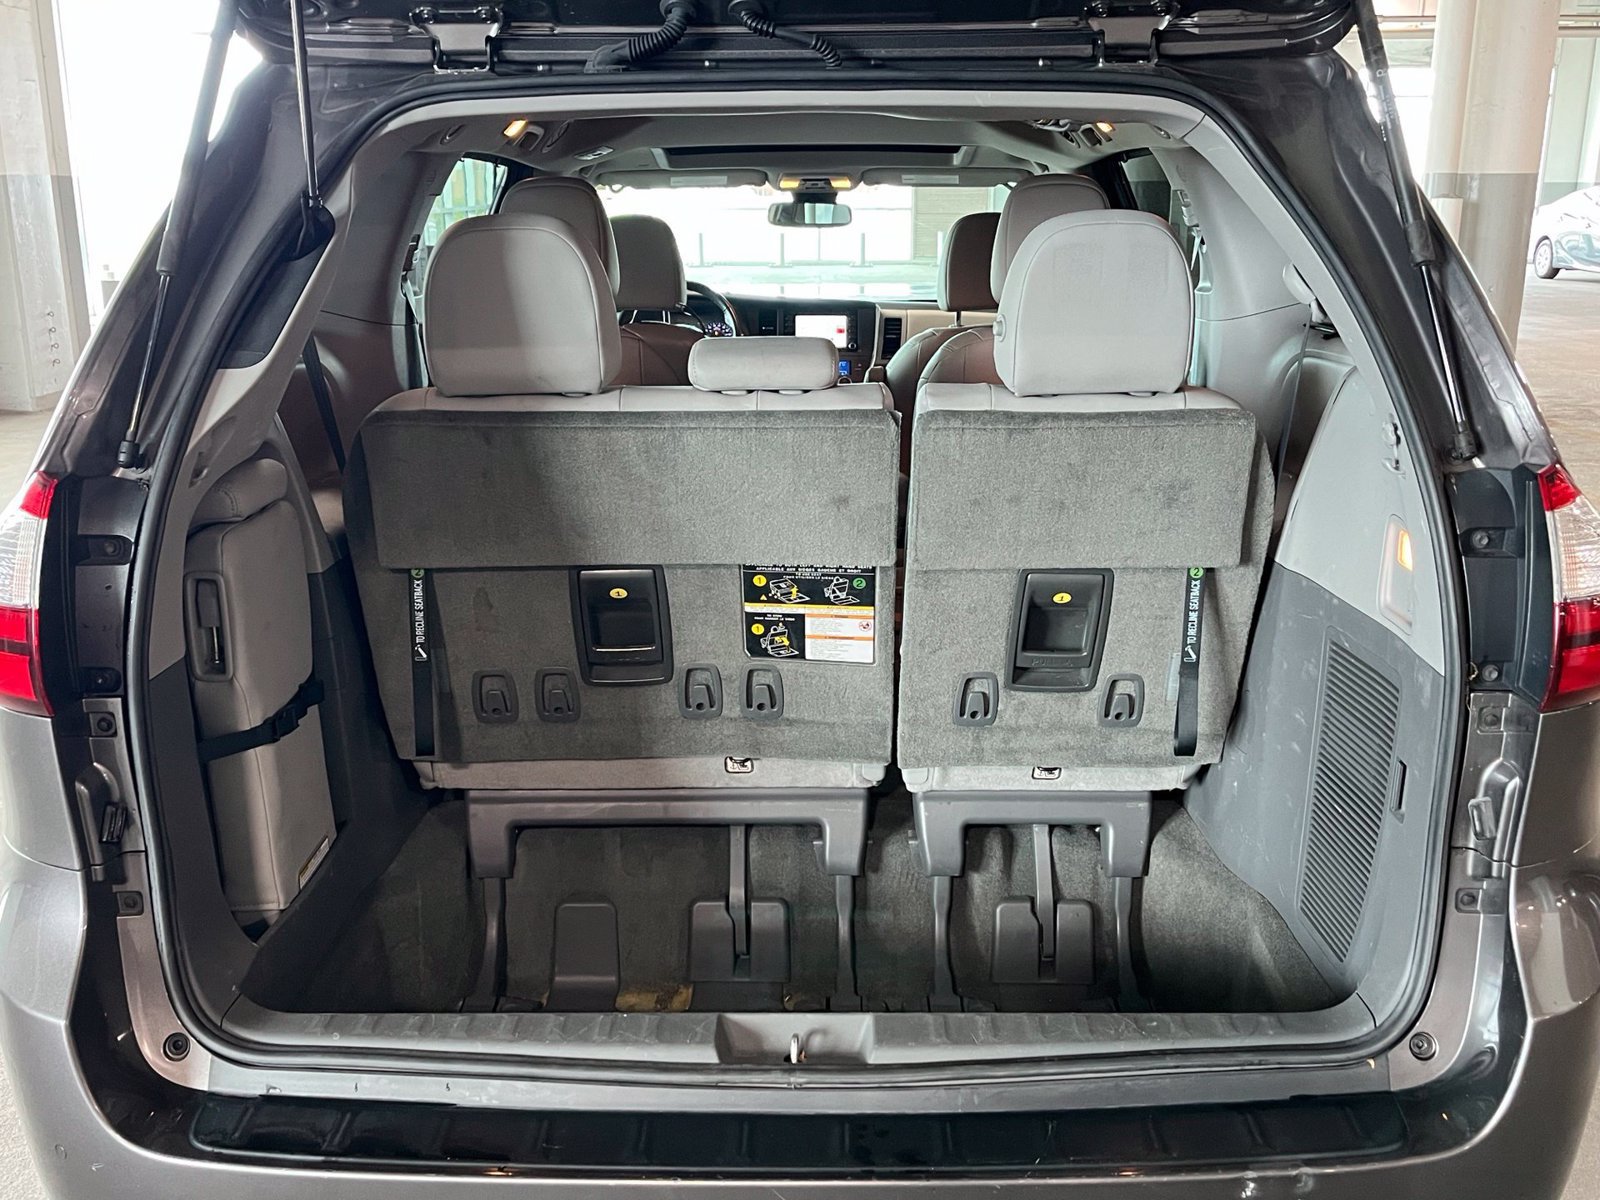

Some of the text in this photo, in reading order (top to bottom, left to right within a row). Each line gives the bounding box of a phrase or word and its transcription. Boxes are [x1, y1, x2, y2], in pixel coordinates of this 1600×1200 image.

[414, 580, 425, 644] TO RECLINE SEATBACK
[1186, 580, 1200, 644] TO RECLINE SEATBACK
